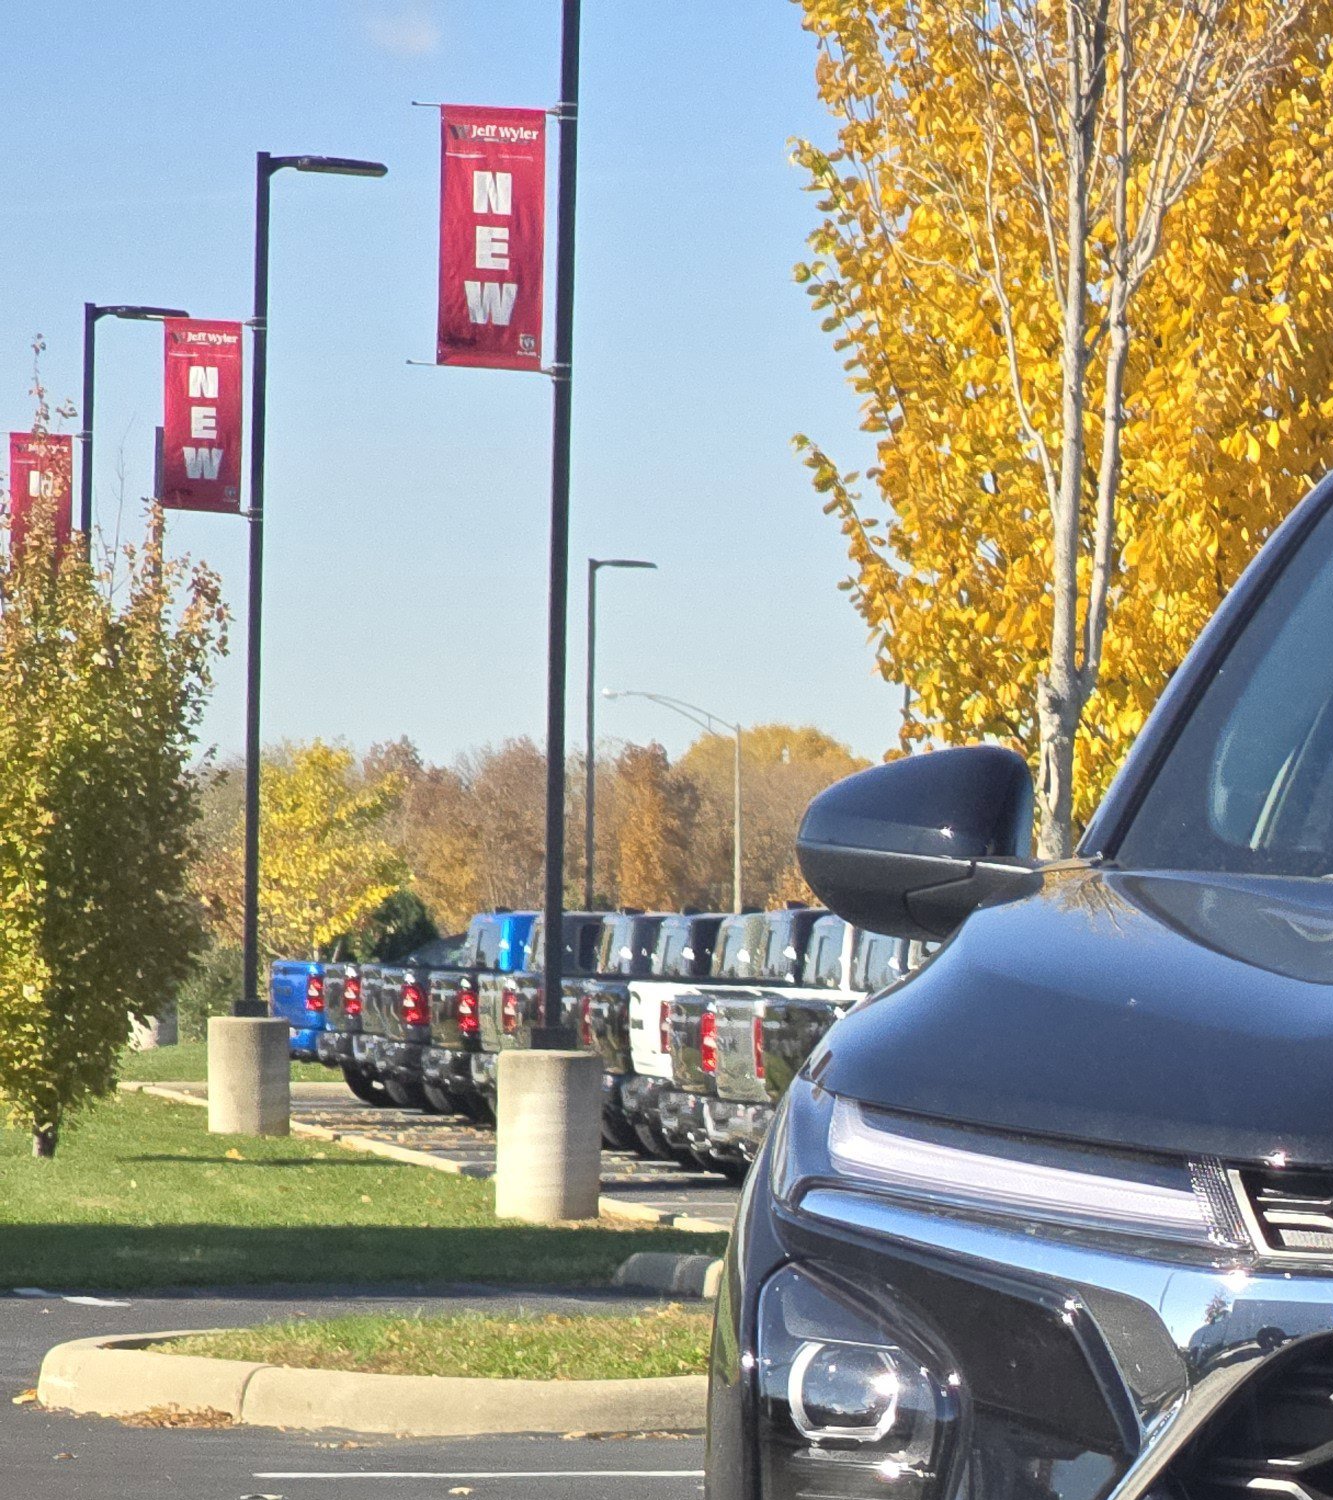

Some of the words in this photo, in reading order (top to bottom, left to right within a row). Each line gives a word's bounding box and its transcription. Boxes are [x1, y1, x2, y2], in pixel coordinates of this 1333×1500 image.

[471, 125, 497, 138] Jeff
[498, 127, 539, 142] Wyler
[464, 170, 518, 326] NEW
[187, 332, 207, 342] Jeff
[207, 333, 238, 345] Wyler
[182, 366, 224, 480] NEW
